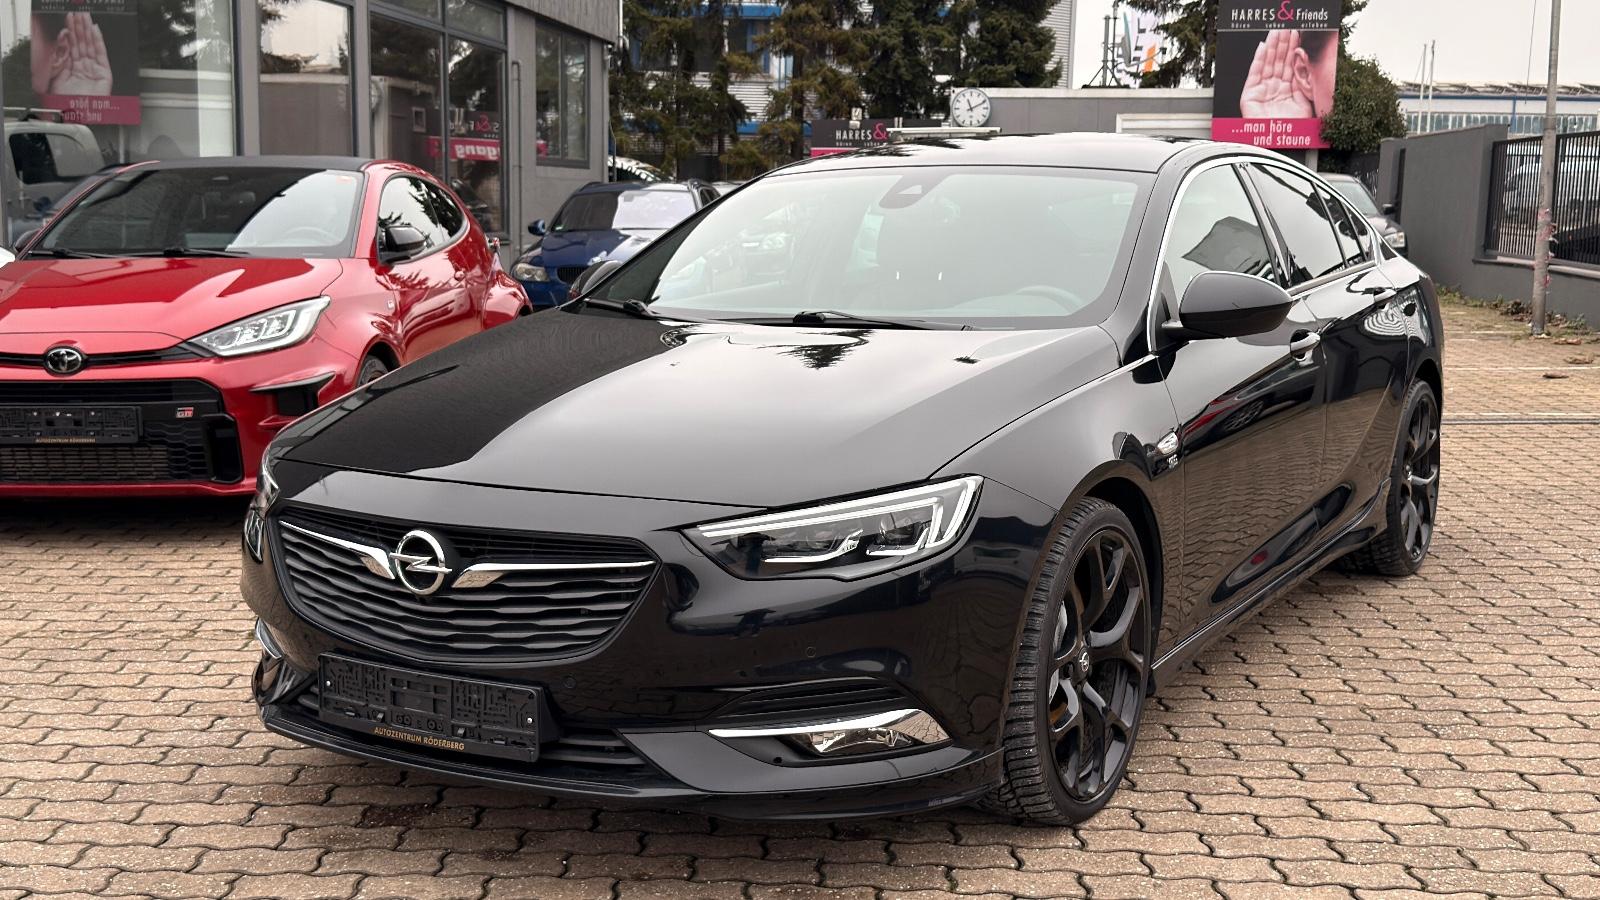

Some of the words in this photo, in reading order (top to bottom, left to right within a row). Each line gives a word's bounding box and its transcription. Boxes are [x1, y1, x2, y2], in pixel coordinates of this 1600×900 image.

[1231, 8, 1276, 21] HARRES
[1296, 8, 1328, 21] Friends
[1269, 119, 1292, 134] höre
[835, 129, 872, 140] HARRES
[1253, 133, 1273, 146] und
[1277, 135, 1311, 146] staune
[374, 726, 422, 743] AUTOZENTRUM
[423, 736, 465, 751] RÖDERBERG
